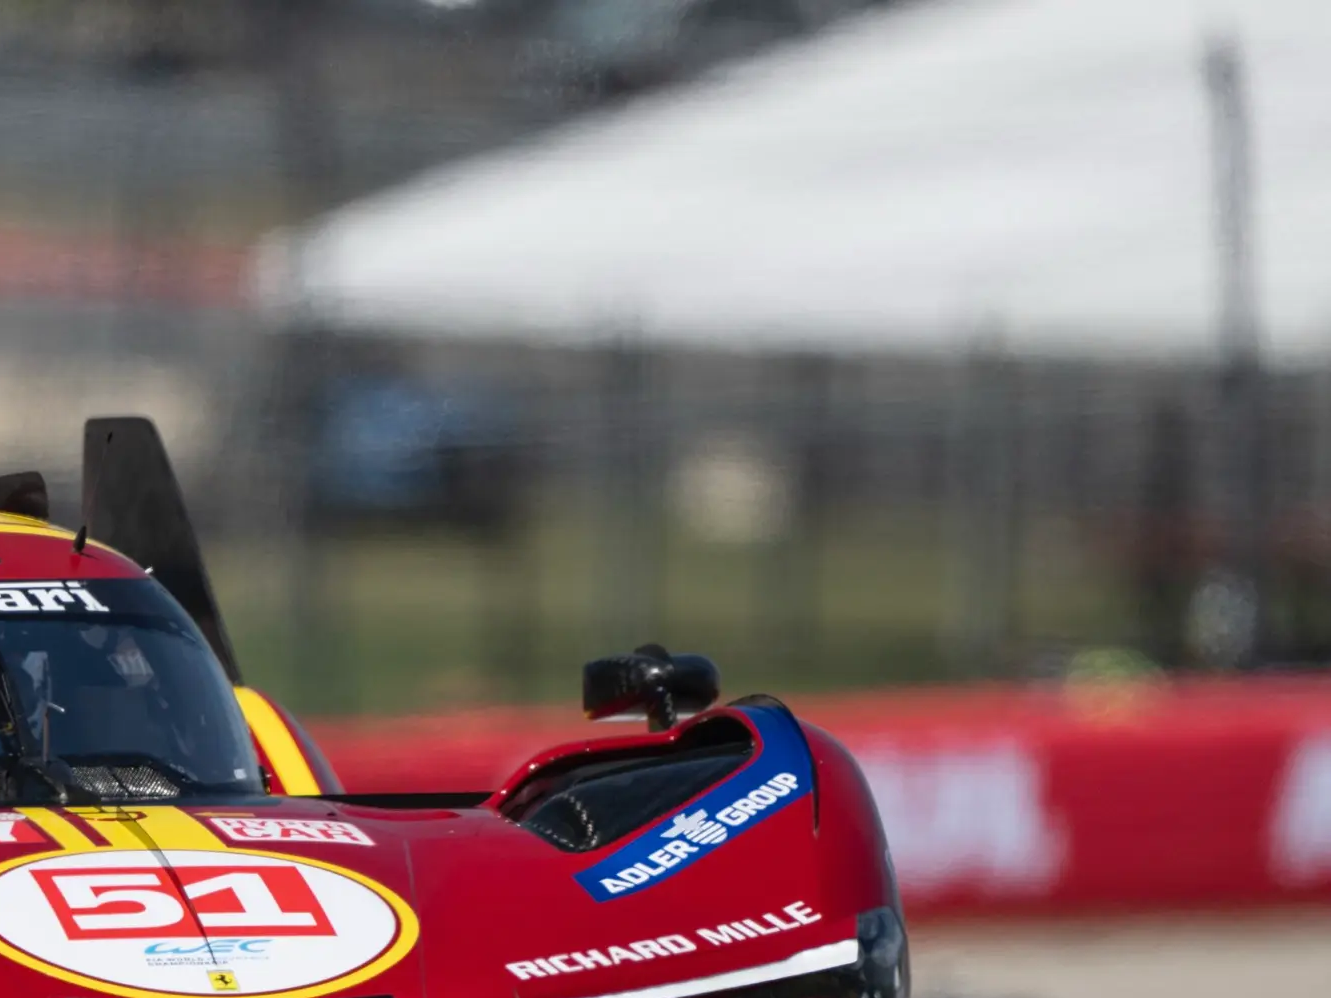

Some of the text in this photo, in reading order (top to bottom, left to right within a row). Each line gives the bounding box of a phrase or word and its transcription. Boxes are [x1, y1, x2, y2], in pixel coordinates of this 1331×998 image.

[599, 772, 799, 894] ADLER GROUP
[51, 872, 318, 931] 51
[144, 938, 273, 955] WEC
[505, 901, 823, 981] RICHARD MILLE
